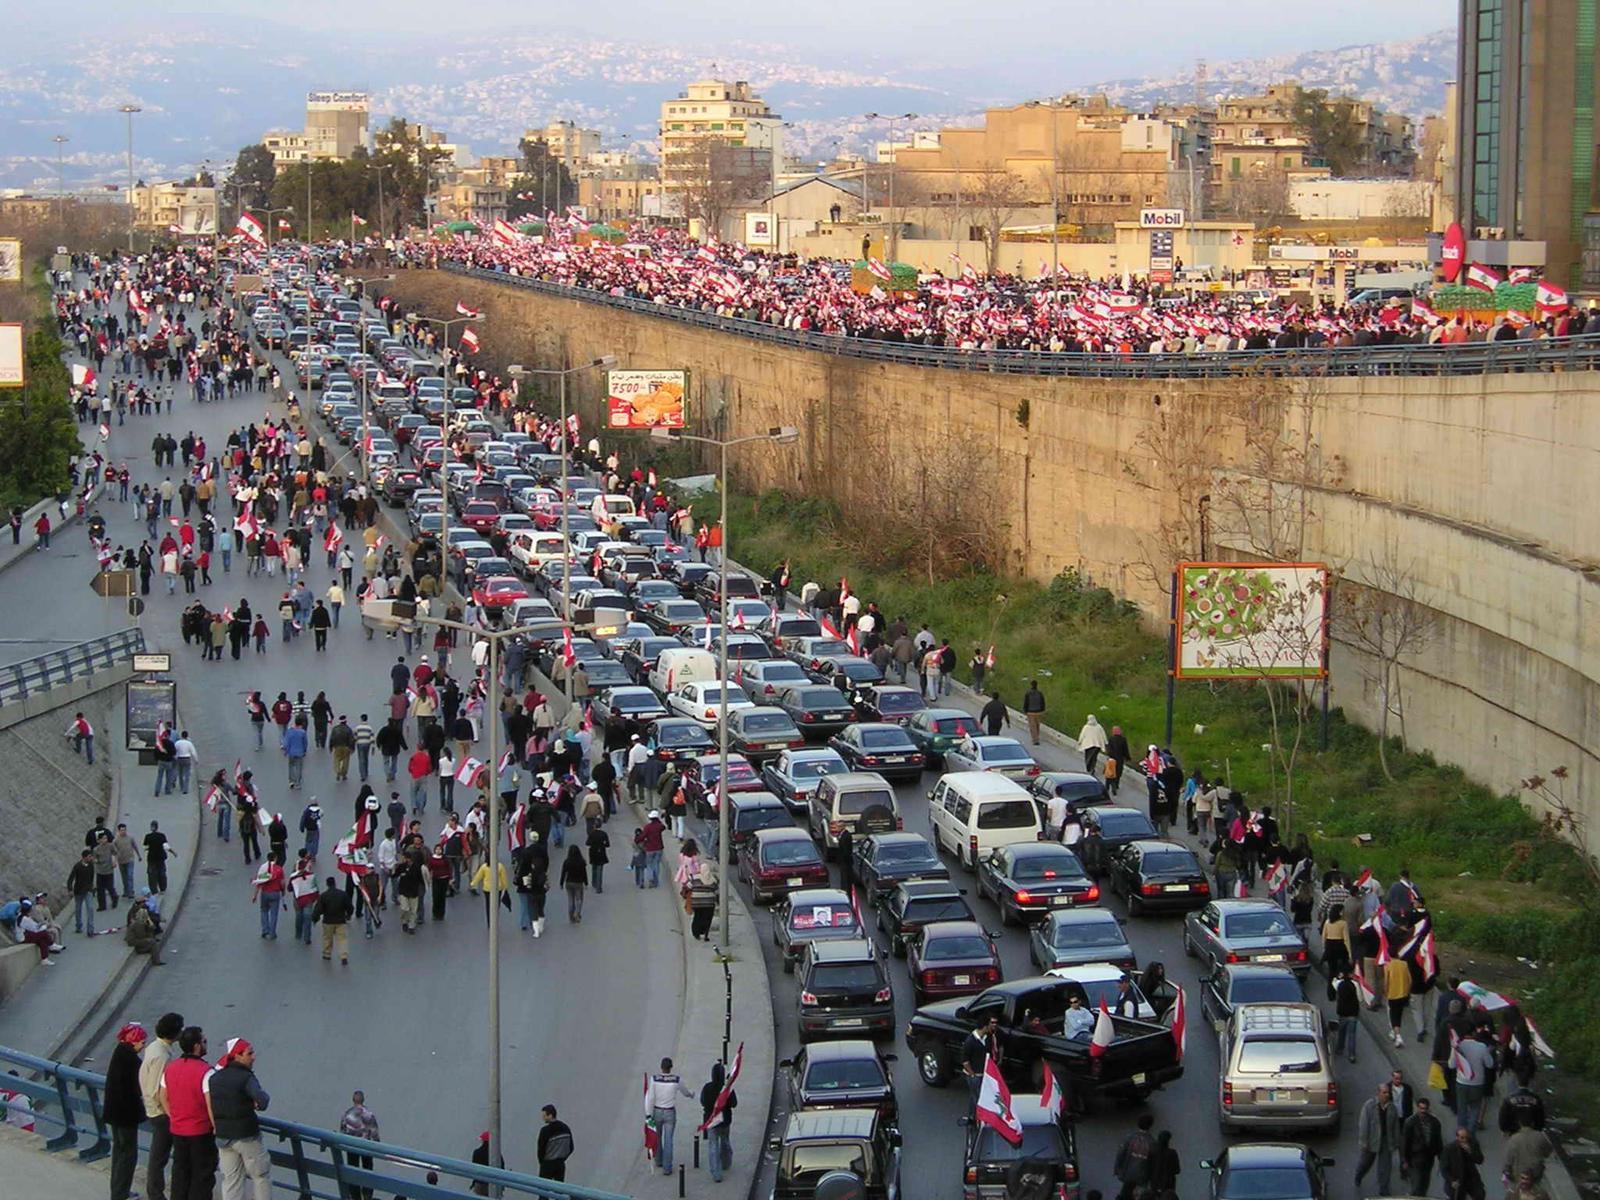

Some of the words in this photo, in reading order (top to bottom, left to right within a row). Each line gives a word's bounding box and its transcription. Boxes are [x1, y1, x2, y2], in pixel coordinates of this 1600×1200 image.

[308, 93, 331, 103] Sleep
[333, 93, 368, 102] Comfort
[1144, 213, 1180, 224] Mobil
[1329, 249, 1359, 258] Mobil
[611, 383, 639, 394] 7500
